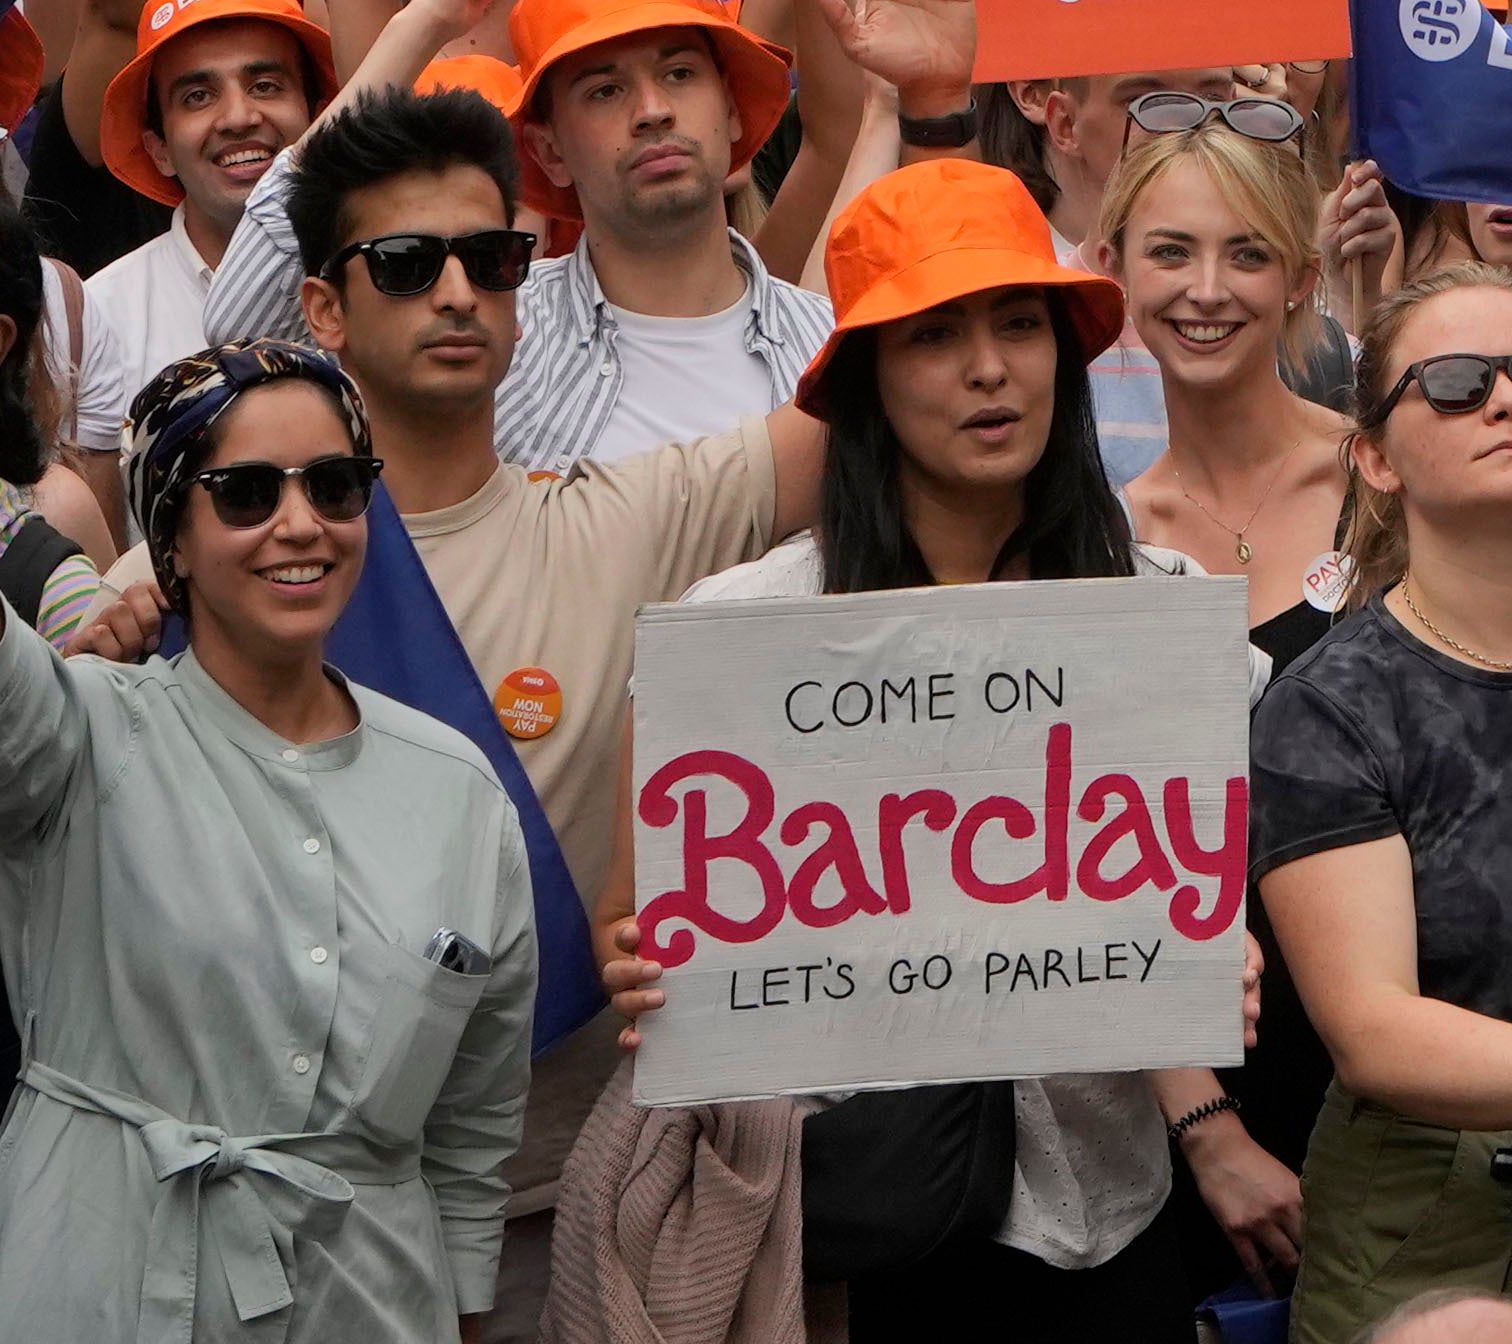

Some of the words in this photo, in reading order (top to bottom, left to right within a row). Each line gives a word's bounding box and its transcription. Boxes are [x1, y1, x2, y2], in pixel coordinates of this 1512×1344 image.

[513, 721, 536, 732] PAY
[514, 698, 543, 711] NOW
[785, 673, 955, 733] COME
[984, 666, 1064, 714] ON
[638, 722, 1248, 968] Barclay
[730, 955, 857, 1013] LET'S
[888, 952, 952, 996] GO
[985, 940, 1162, 995] PARLEY
